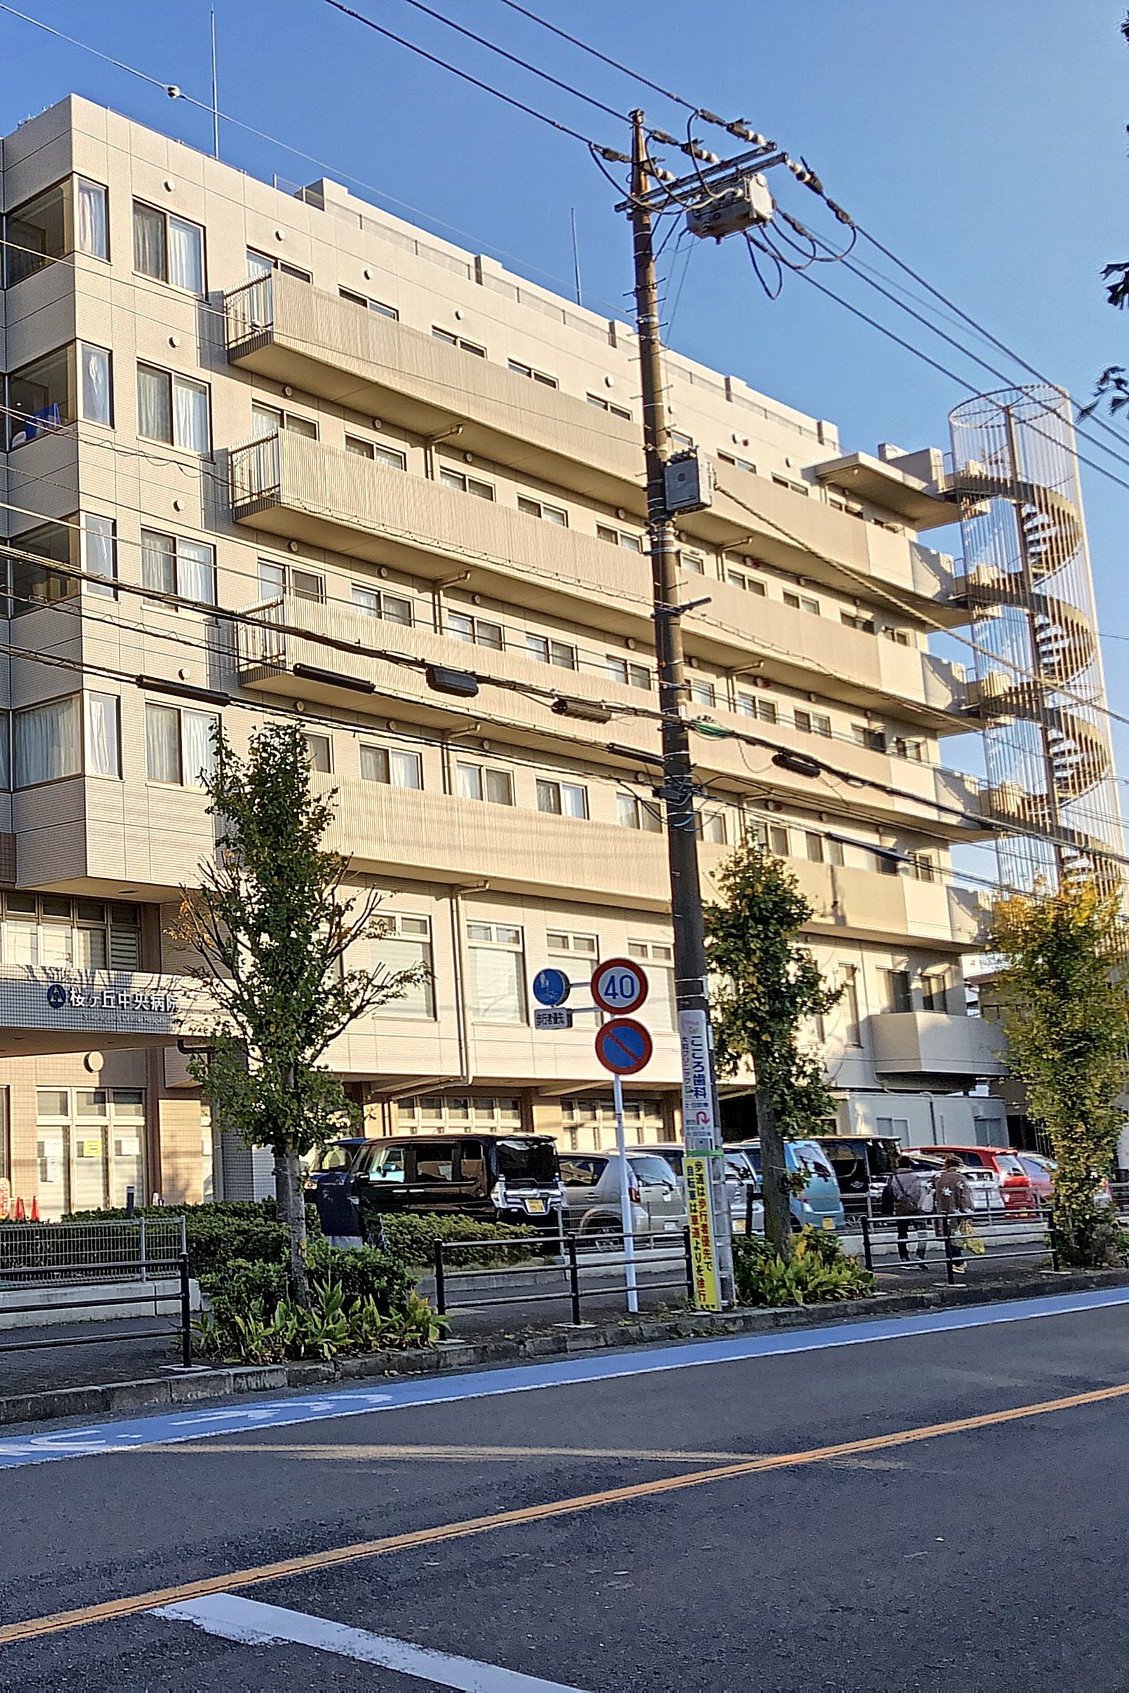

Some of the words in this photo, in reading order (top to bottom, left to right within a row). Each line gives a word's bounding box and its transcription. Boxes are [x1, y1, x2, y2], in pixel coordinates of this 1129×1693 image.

[604, 974, 635, 1000] 40
[691, 1035, 707, 1099] こころ歯科
[694, 1160, 713, 1272] 歩道は歩行者優先で
